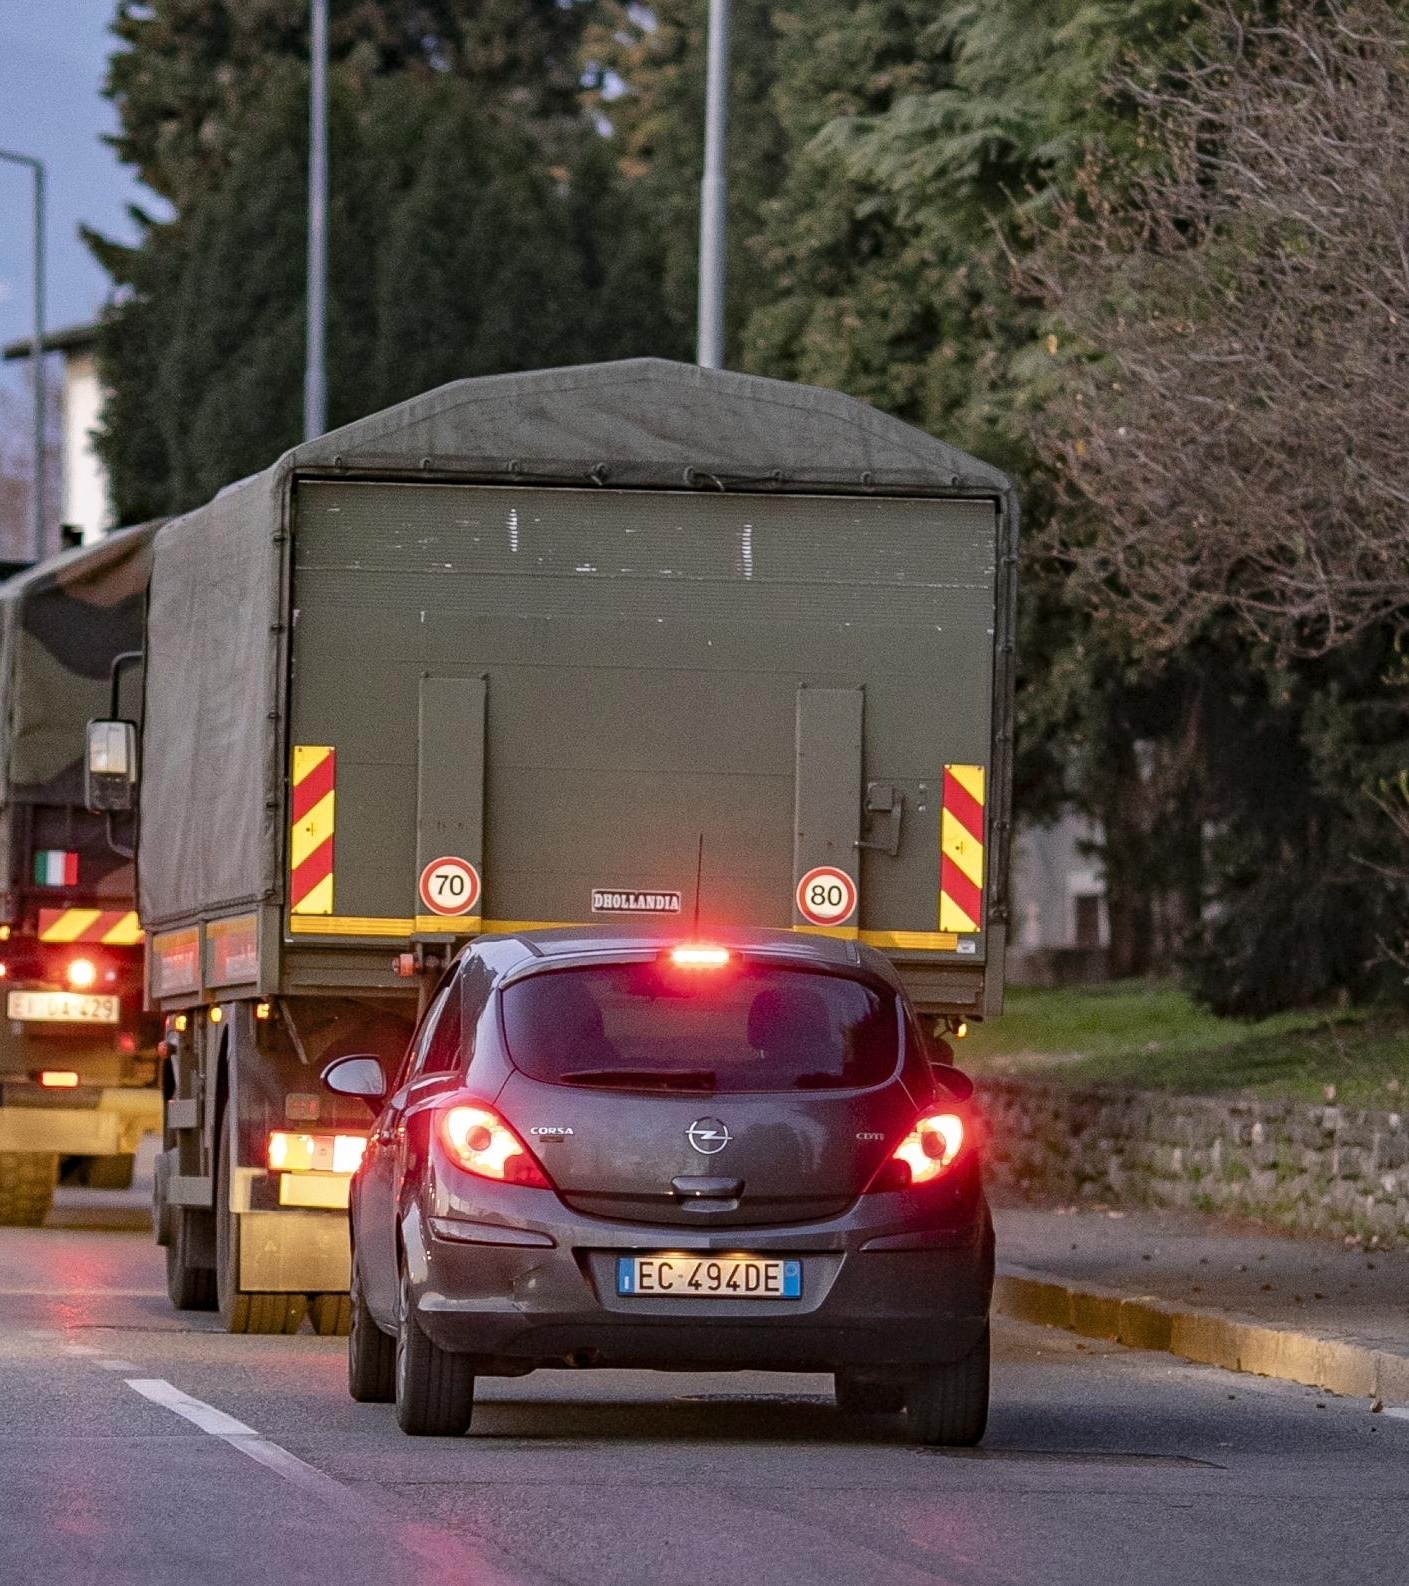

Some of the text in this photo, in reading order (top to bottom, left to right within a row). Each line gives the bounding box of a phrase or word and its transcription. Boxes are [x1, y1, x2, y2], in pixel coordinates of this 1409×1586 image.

[435, 874, 464, 896] 70
[811, 884, 842, 906] 80
[594, 893, 679, 911] DHOLLANDIA
[530, 1127, 574, 1135] CORSA
[639, 1261, 674, 1290] EC
[687, 1262, 780, 1292] 494DE
